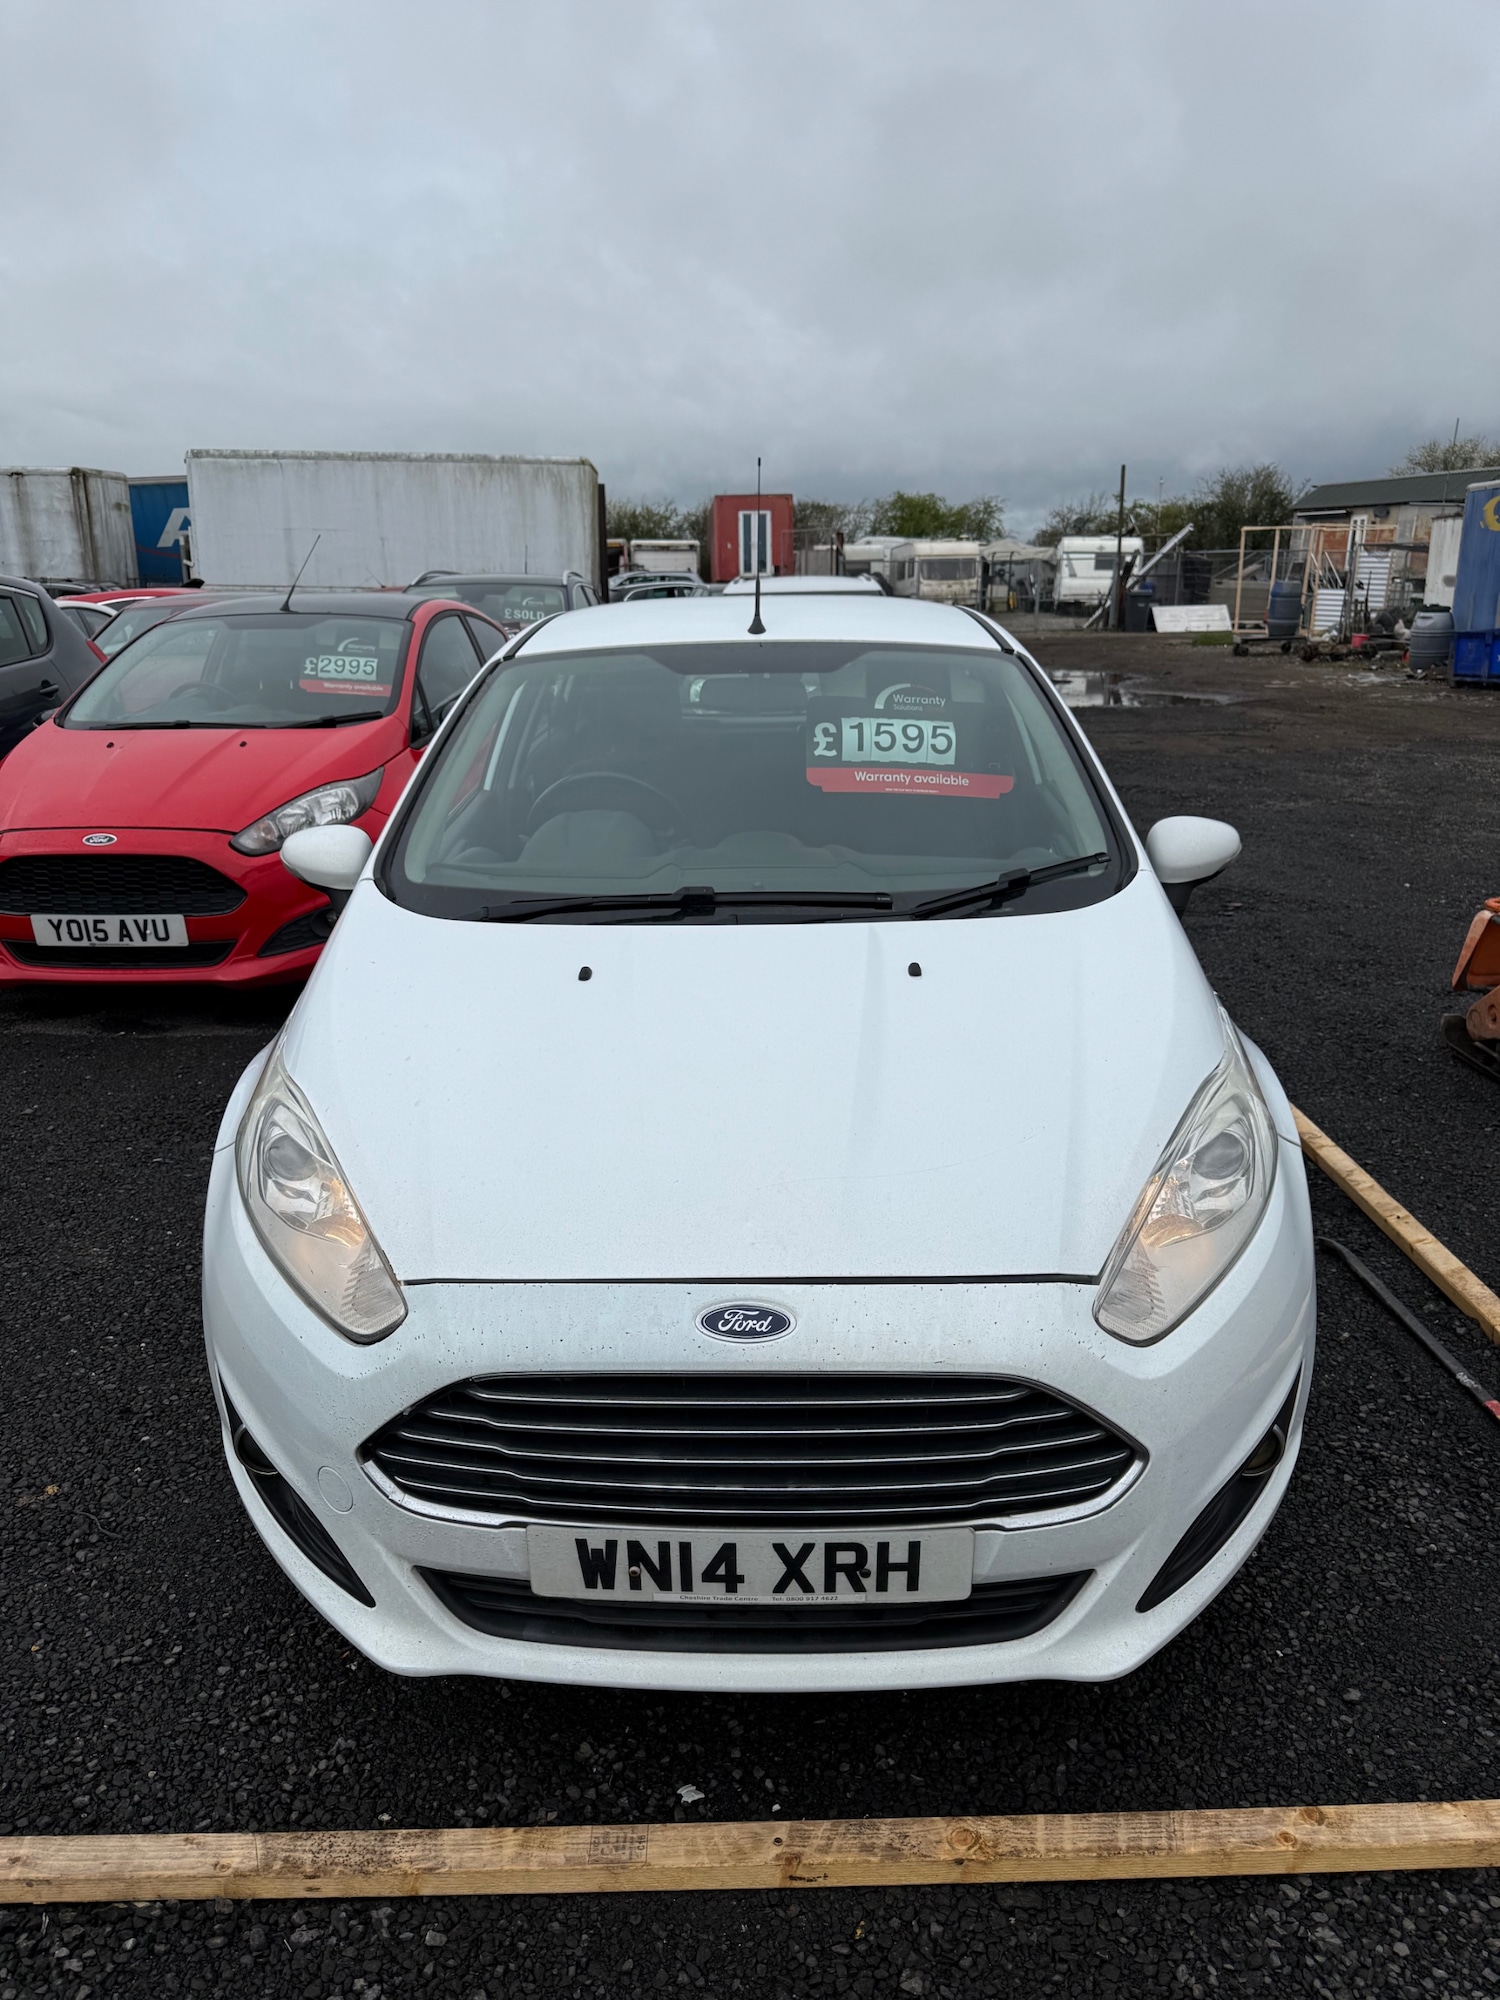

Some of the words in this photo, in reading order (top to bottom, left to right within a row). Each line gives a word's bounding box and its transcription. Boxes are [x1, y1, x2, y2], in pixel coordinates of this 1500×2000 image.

[893, 693, 946, 708] Warranty
[854, 771, 911, 785] Warranty
[914, 773, 970, 786] available
[47, 919, 109, 942] YO15
[119, 919, 170, 942] AVU
[718, 1309, 773, 1332] Ford
[574, 1537, 745, 1594] WN14
[771, 1540, 922, 1595] XRH
